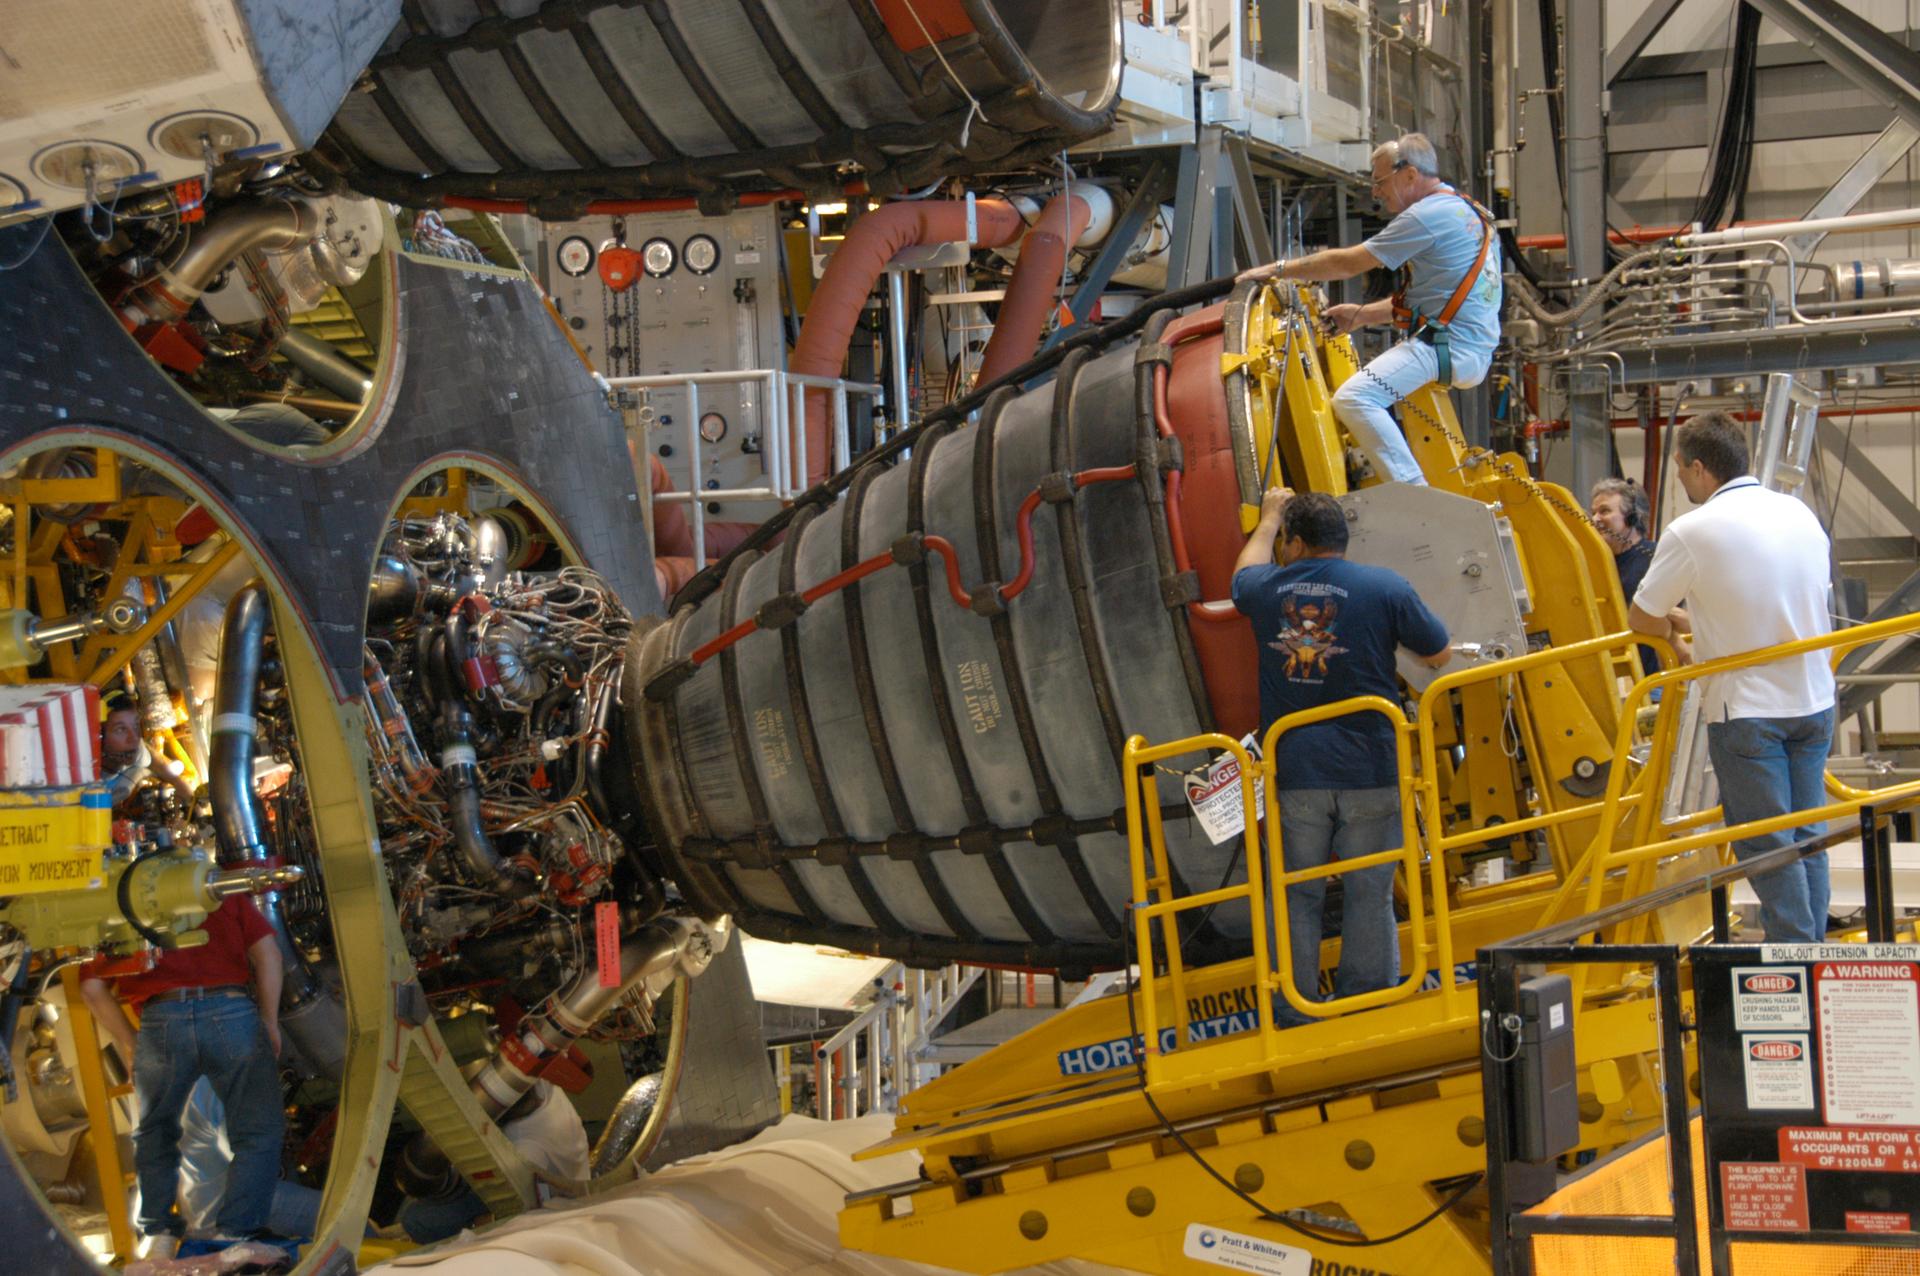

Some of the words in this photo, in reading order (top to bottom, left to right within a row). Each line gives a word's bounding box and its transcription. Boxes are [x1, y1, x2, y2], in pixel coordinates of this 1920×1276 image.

[29, 858, 92, 881] MOVEMENT
[1772, 947, 1813, 960] ROLL-OUT
[1820, 947, 1868, 959] EXTENSION
[1874, 946, 1917, 958] CAPACITY
[1837, 965, 1911, 979] WARNING
[1752, 977, 1788, 990] DANGER
[1743, 1005, 1758, 1013] KEEP
[1760, 1005, 1781, 1013] HANDS
[1781, 1005, 1801, 1013] CLEAR
[1062, 1011, 1258, 1075] HORONTAL
[1757, 1045, 1796, 1057] DANGER
[1789, 1131, 1842, 1141] MAXIMUM
[1848, 1132, 1909, 1143] PLATFORM
[1792, 1144, 1799, 1153] 4
[1801, 1143, 1869, 1154] OCCUPANTS
[1878, 1145, 1896, 1155] OR
[1905, 1146, 1913, 1156] A
[1819, 1156, 1835, 1166] OF
[1747, 1166, 1785, 1174] EQUIPMENT
[1790, 1166, 1797, 1174] IS
[1728, 1174, 1765, 1182] APPROVED
[1769, 1174, 1778, 1182] TO
[1783, 1174, 1797, 1182] LIFT
[1740, 1194, 1748, 1202] IS
[1751, 1194, 1765, 1202] NOT
[1784, 1195, 1793, 1203] BE
[1763, 1203, 1787, 1211] CLOSE
[1222, 1235, 1242, 1248] Pratt
[1243, 1240, 1250, 1250] &
[1253, 1241, 1288, 1260] Whitney
